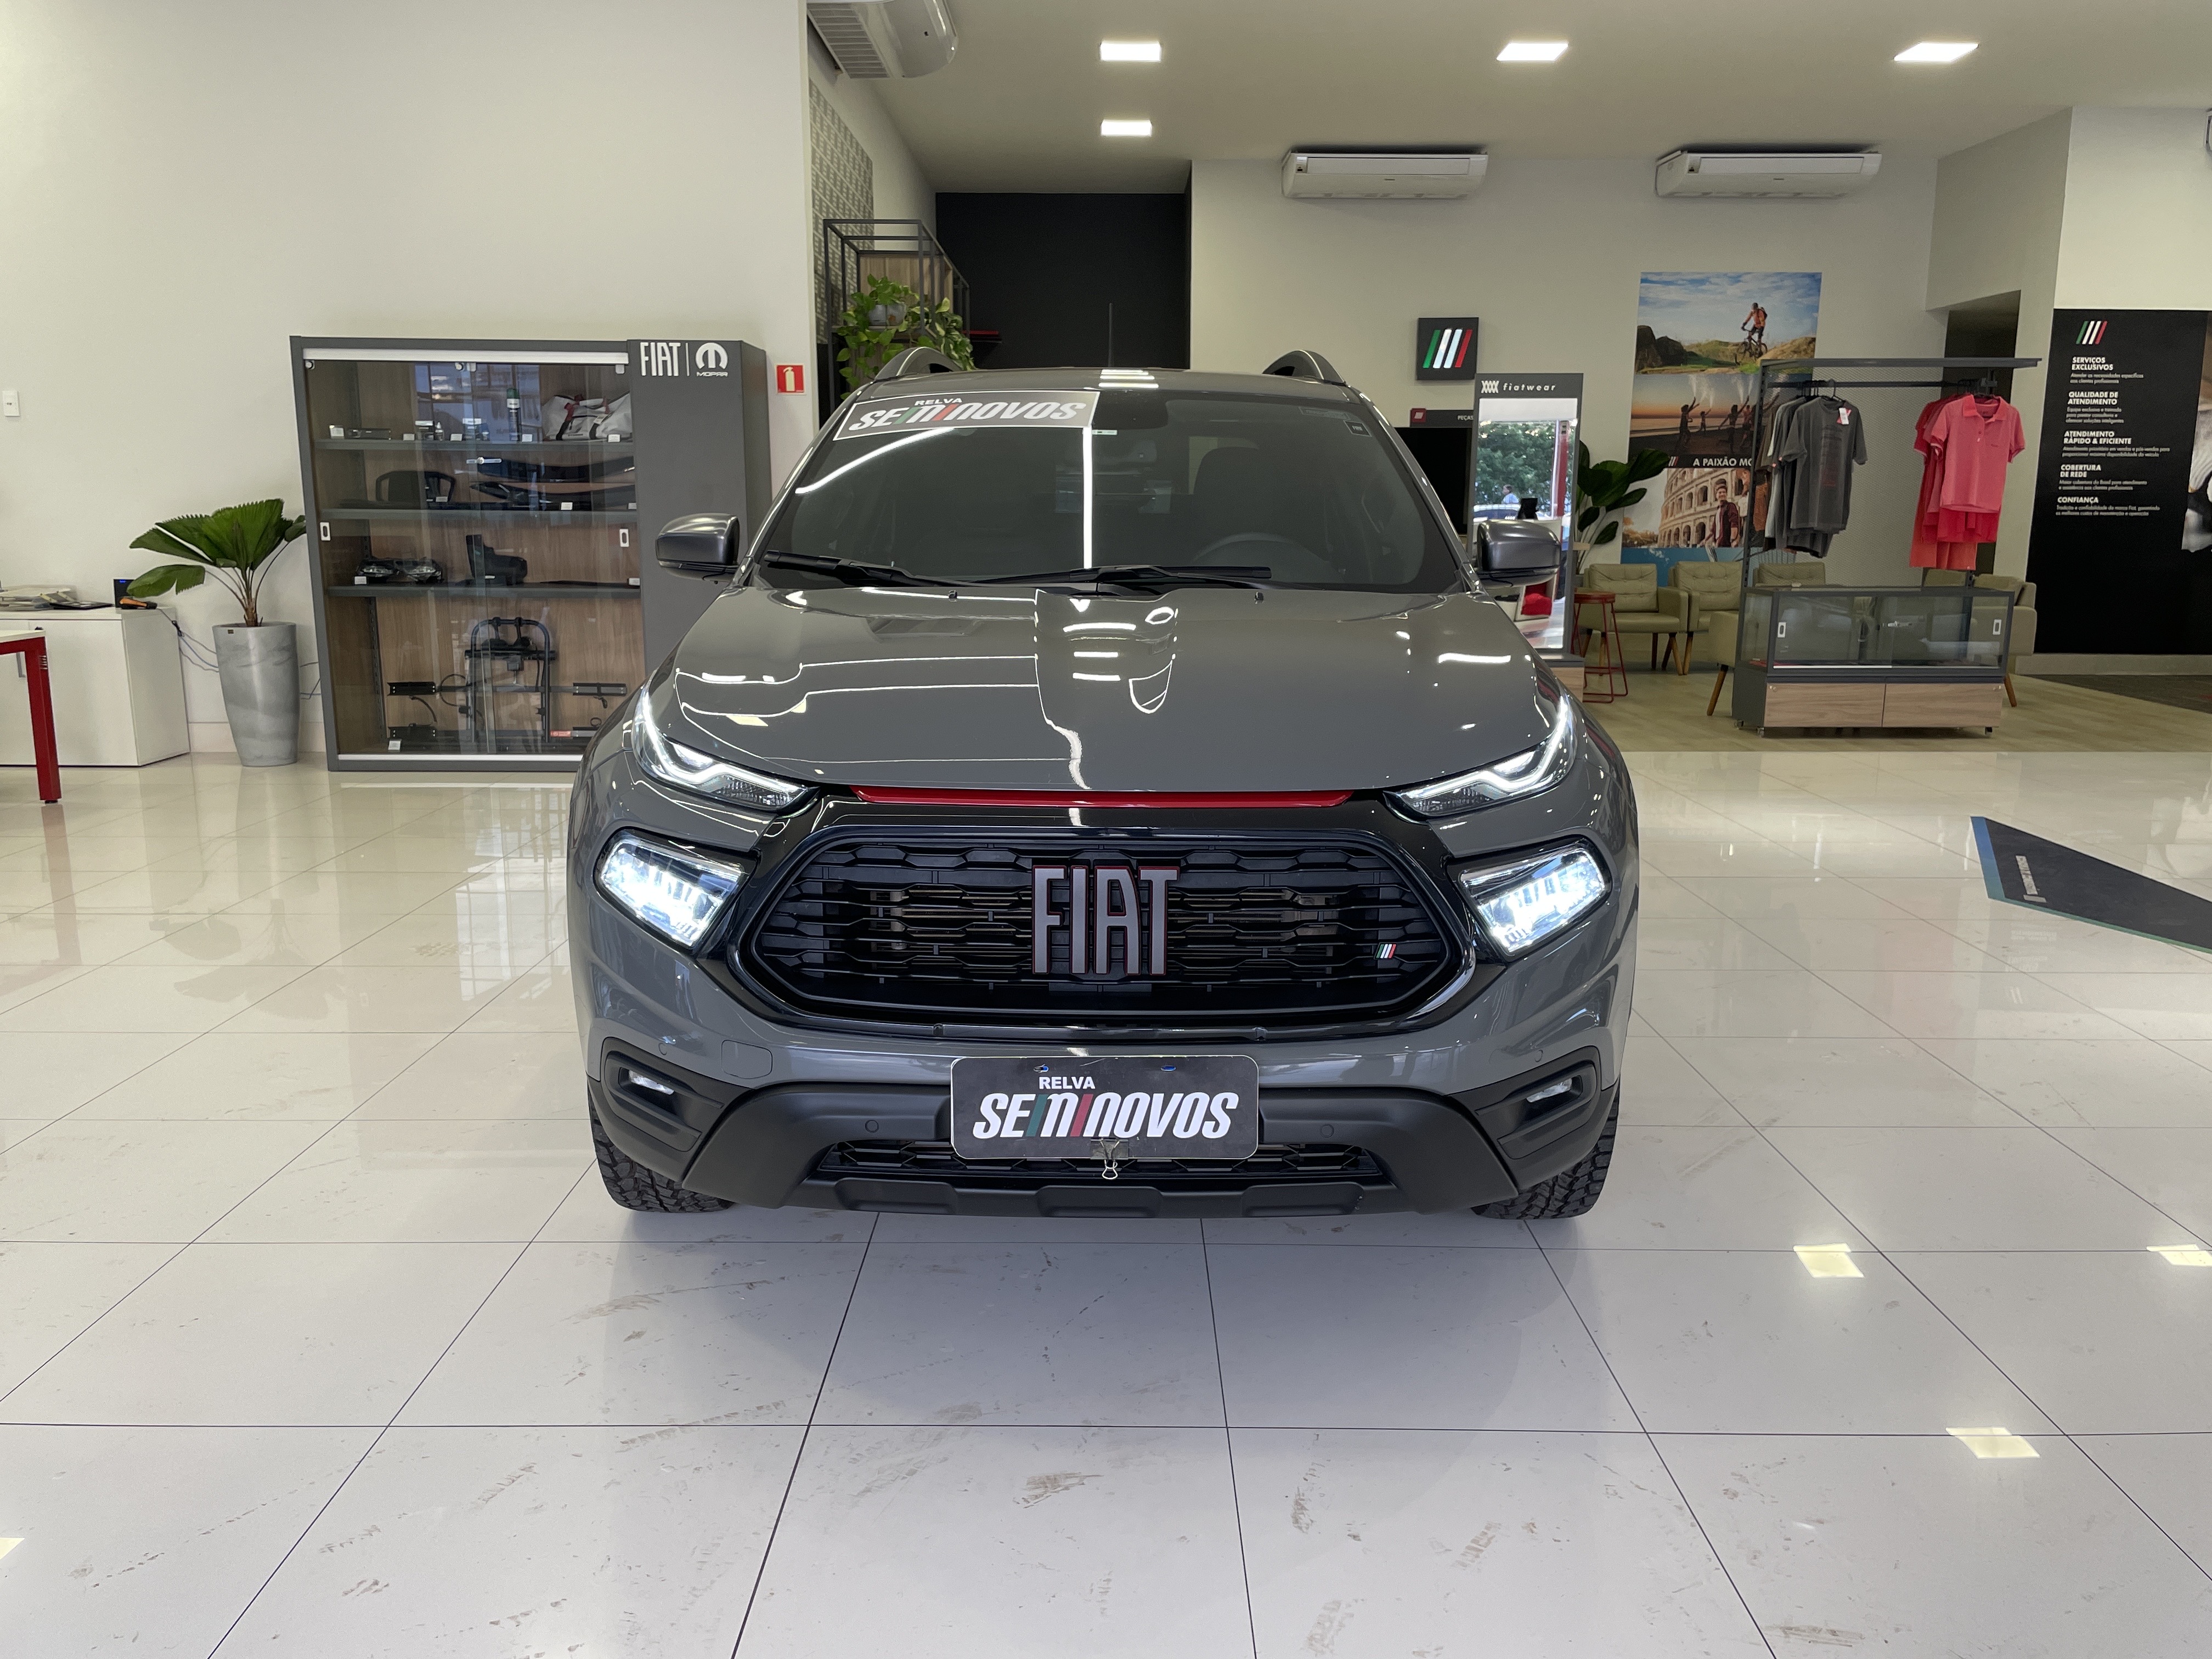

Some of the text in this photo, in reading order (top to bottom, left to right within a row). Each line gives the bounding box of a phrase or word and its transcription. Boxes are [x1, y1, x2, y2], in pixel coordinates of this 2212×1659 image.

[640, 342, 681, 376] FIAT
[1503, 383, 1556, 391] fiatwear
[915, 398, 962, 406] RELVA
[848, 402, 1087, 431] SEMINOVOS
[2063, 436, 2091, 444] RÁPIDO
[1692, 458, 1700, 466] A
[1702, 456, 1737, 466] PAIXÃO
[1032, 865, 1180, 975] FIAT
[1039, 1076, 1096, 1090] RELVA
[973, 1092, 1239, 1139] SEMINOVOS
